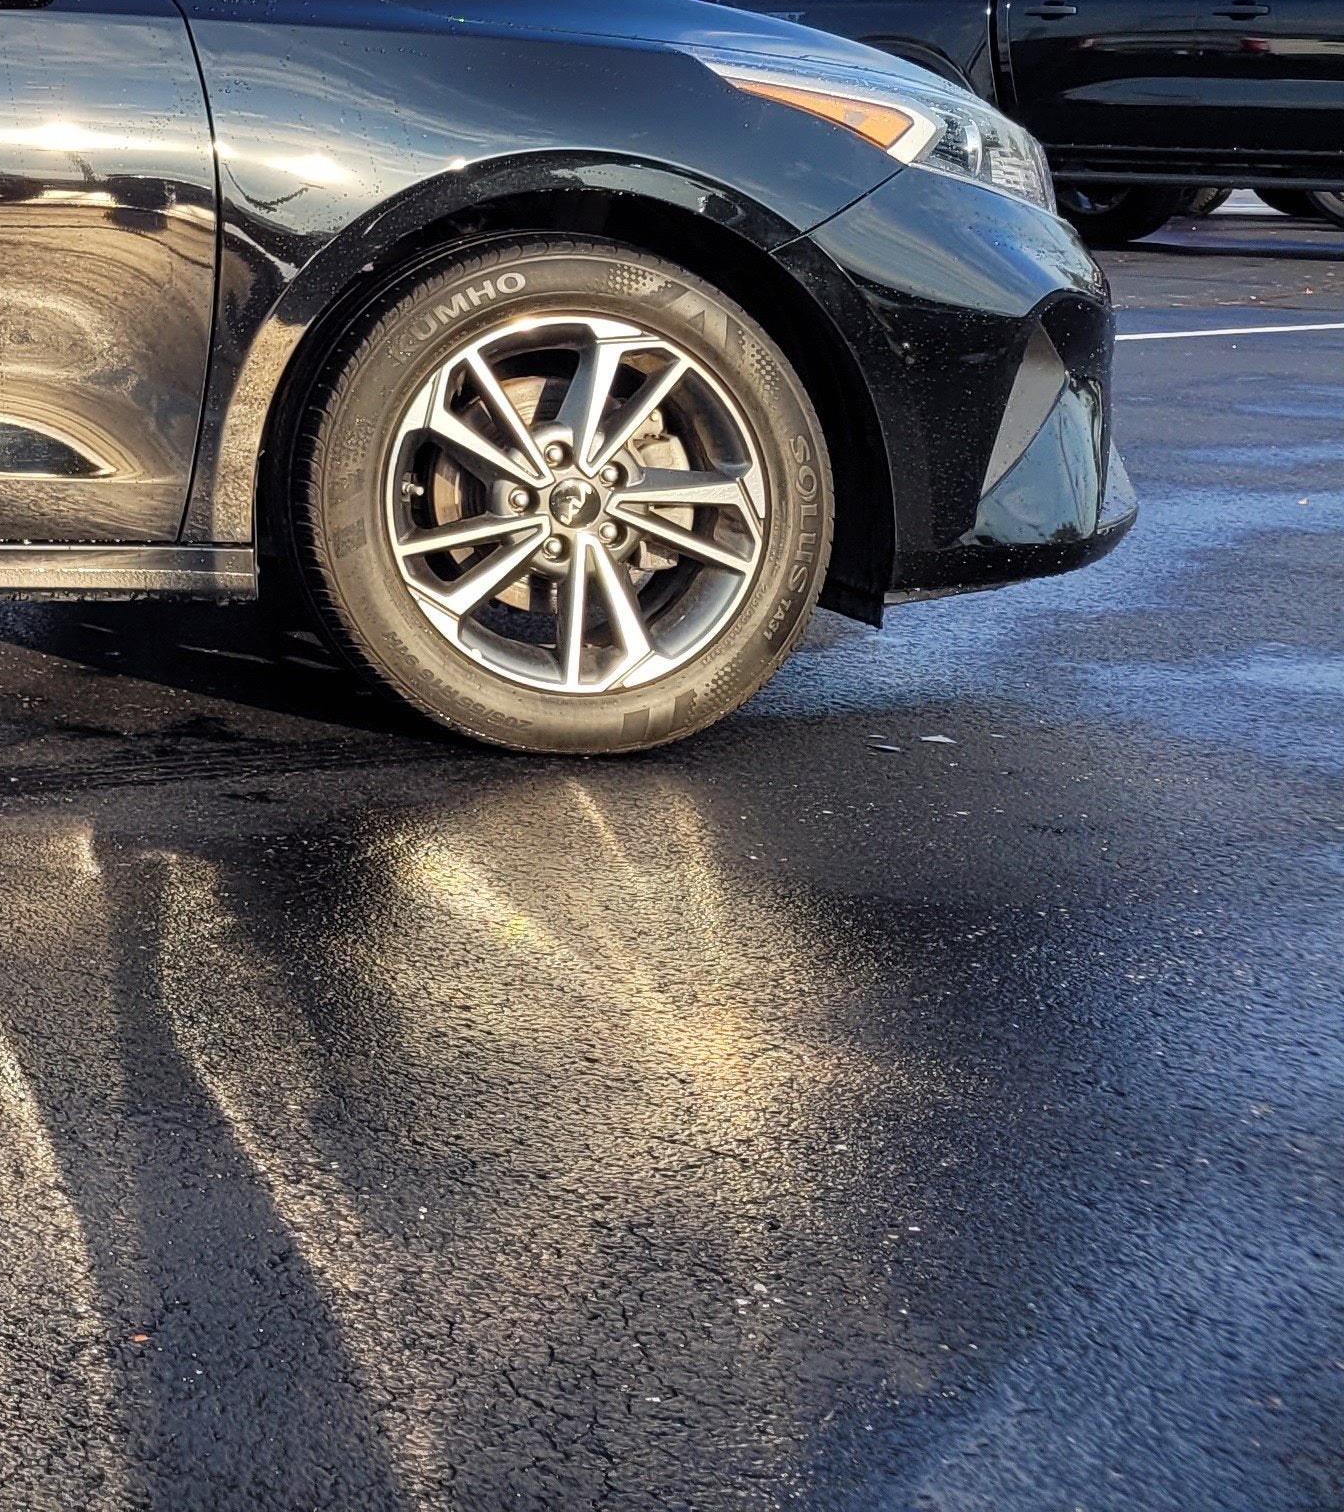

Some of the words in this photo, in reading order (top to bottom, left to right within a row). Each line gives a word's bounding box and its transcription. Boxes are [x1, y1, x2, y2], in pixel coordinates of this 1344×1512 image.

[388, 272, 527, 364] KUMHO
[789, 435, 819, 593] SOLUS
[762, 598, 792, 641] TA31
